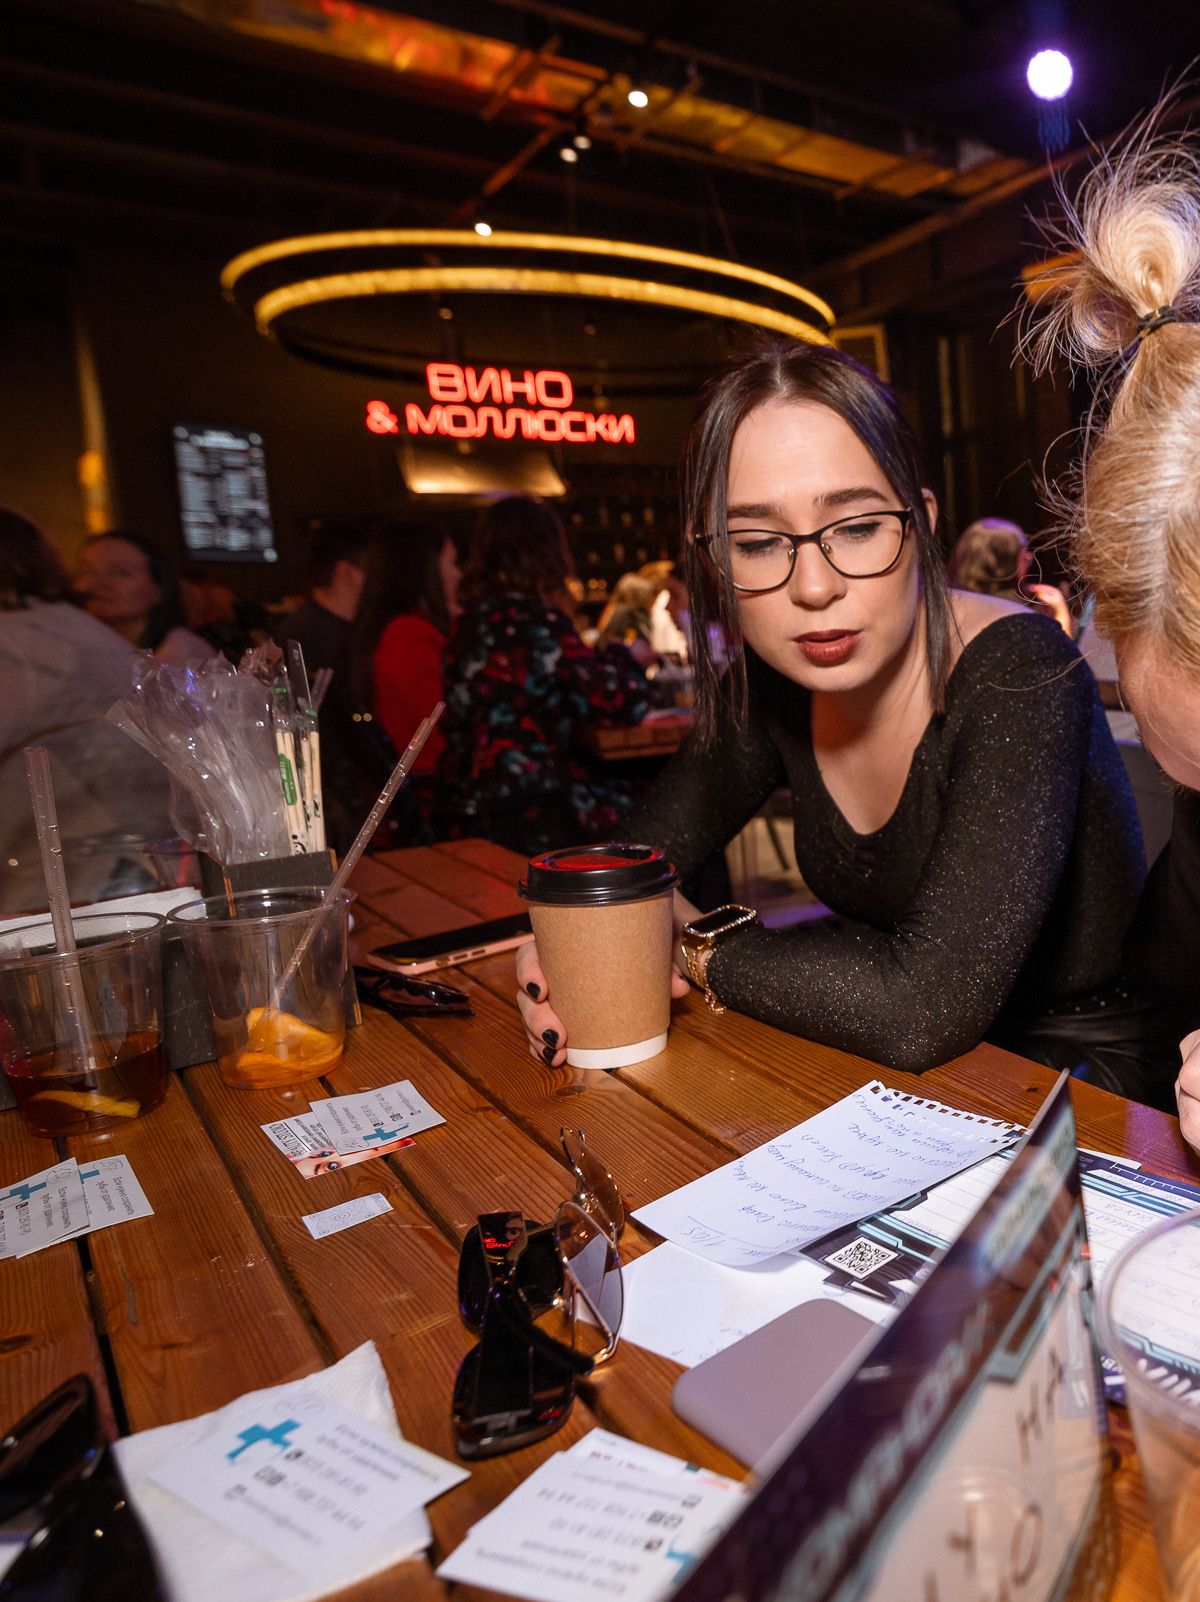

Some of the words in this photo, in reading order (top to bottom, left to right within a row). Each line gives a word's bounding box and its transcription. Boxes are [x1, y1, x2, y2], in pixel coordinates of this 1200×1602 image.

[426, 363, 573, 408] ВИНО
[366, 400, 399, 434] &
[405, 403, 635, 443] МОЛЛЮСКИ
